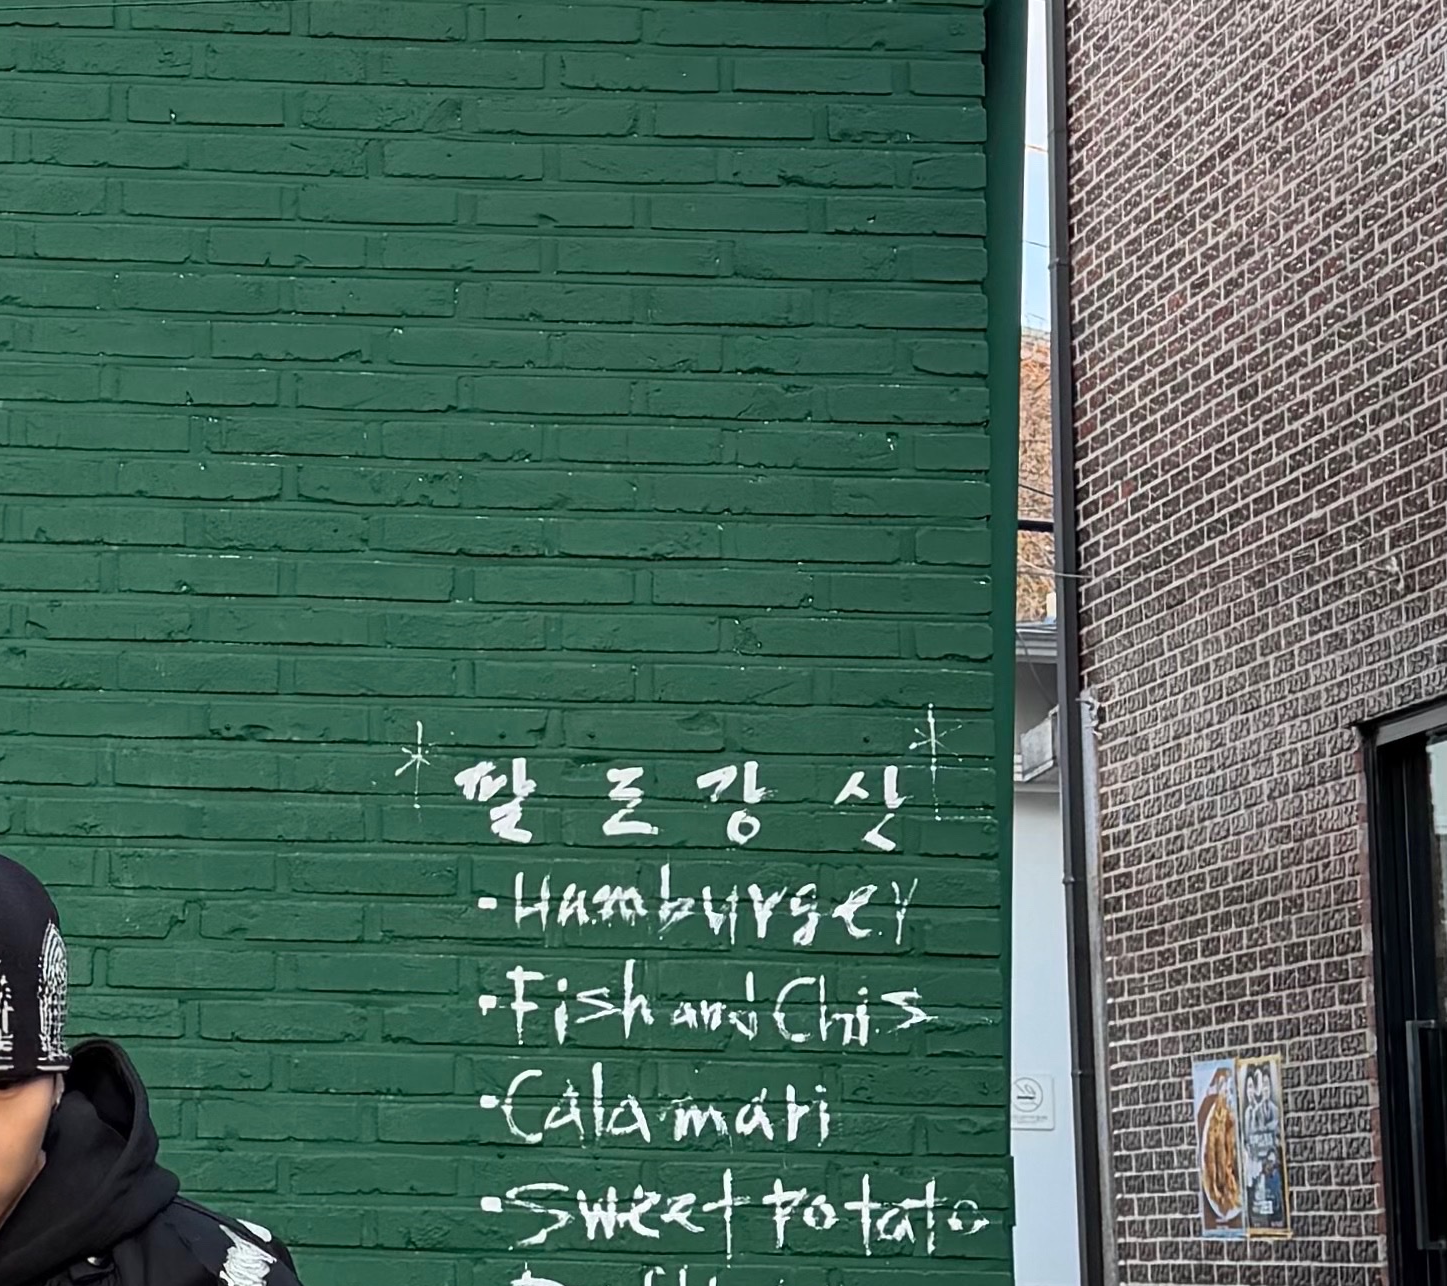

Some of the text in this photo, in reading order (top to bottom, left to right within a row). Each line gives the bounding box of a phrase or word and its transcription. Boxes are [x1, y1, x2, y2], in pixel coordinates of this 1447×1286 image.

[505, 959, 655, 1045] Fish
[671, 970, 758, 1041] and
[506, 1168, 751, 1255] Sweet
